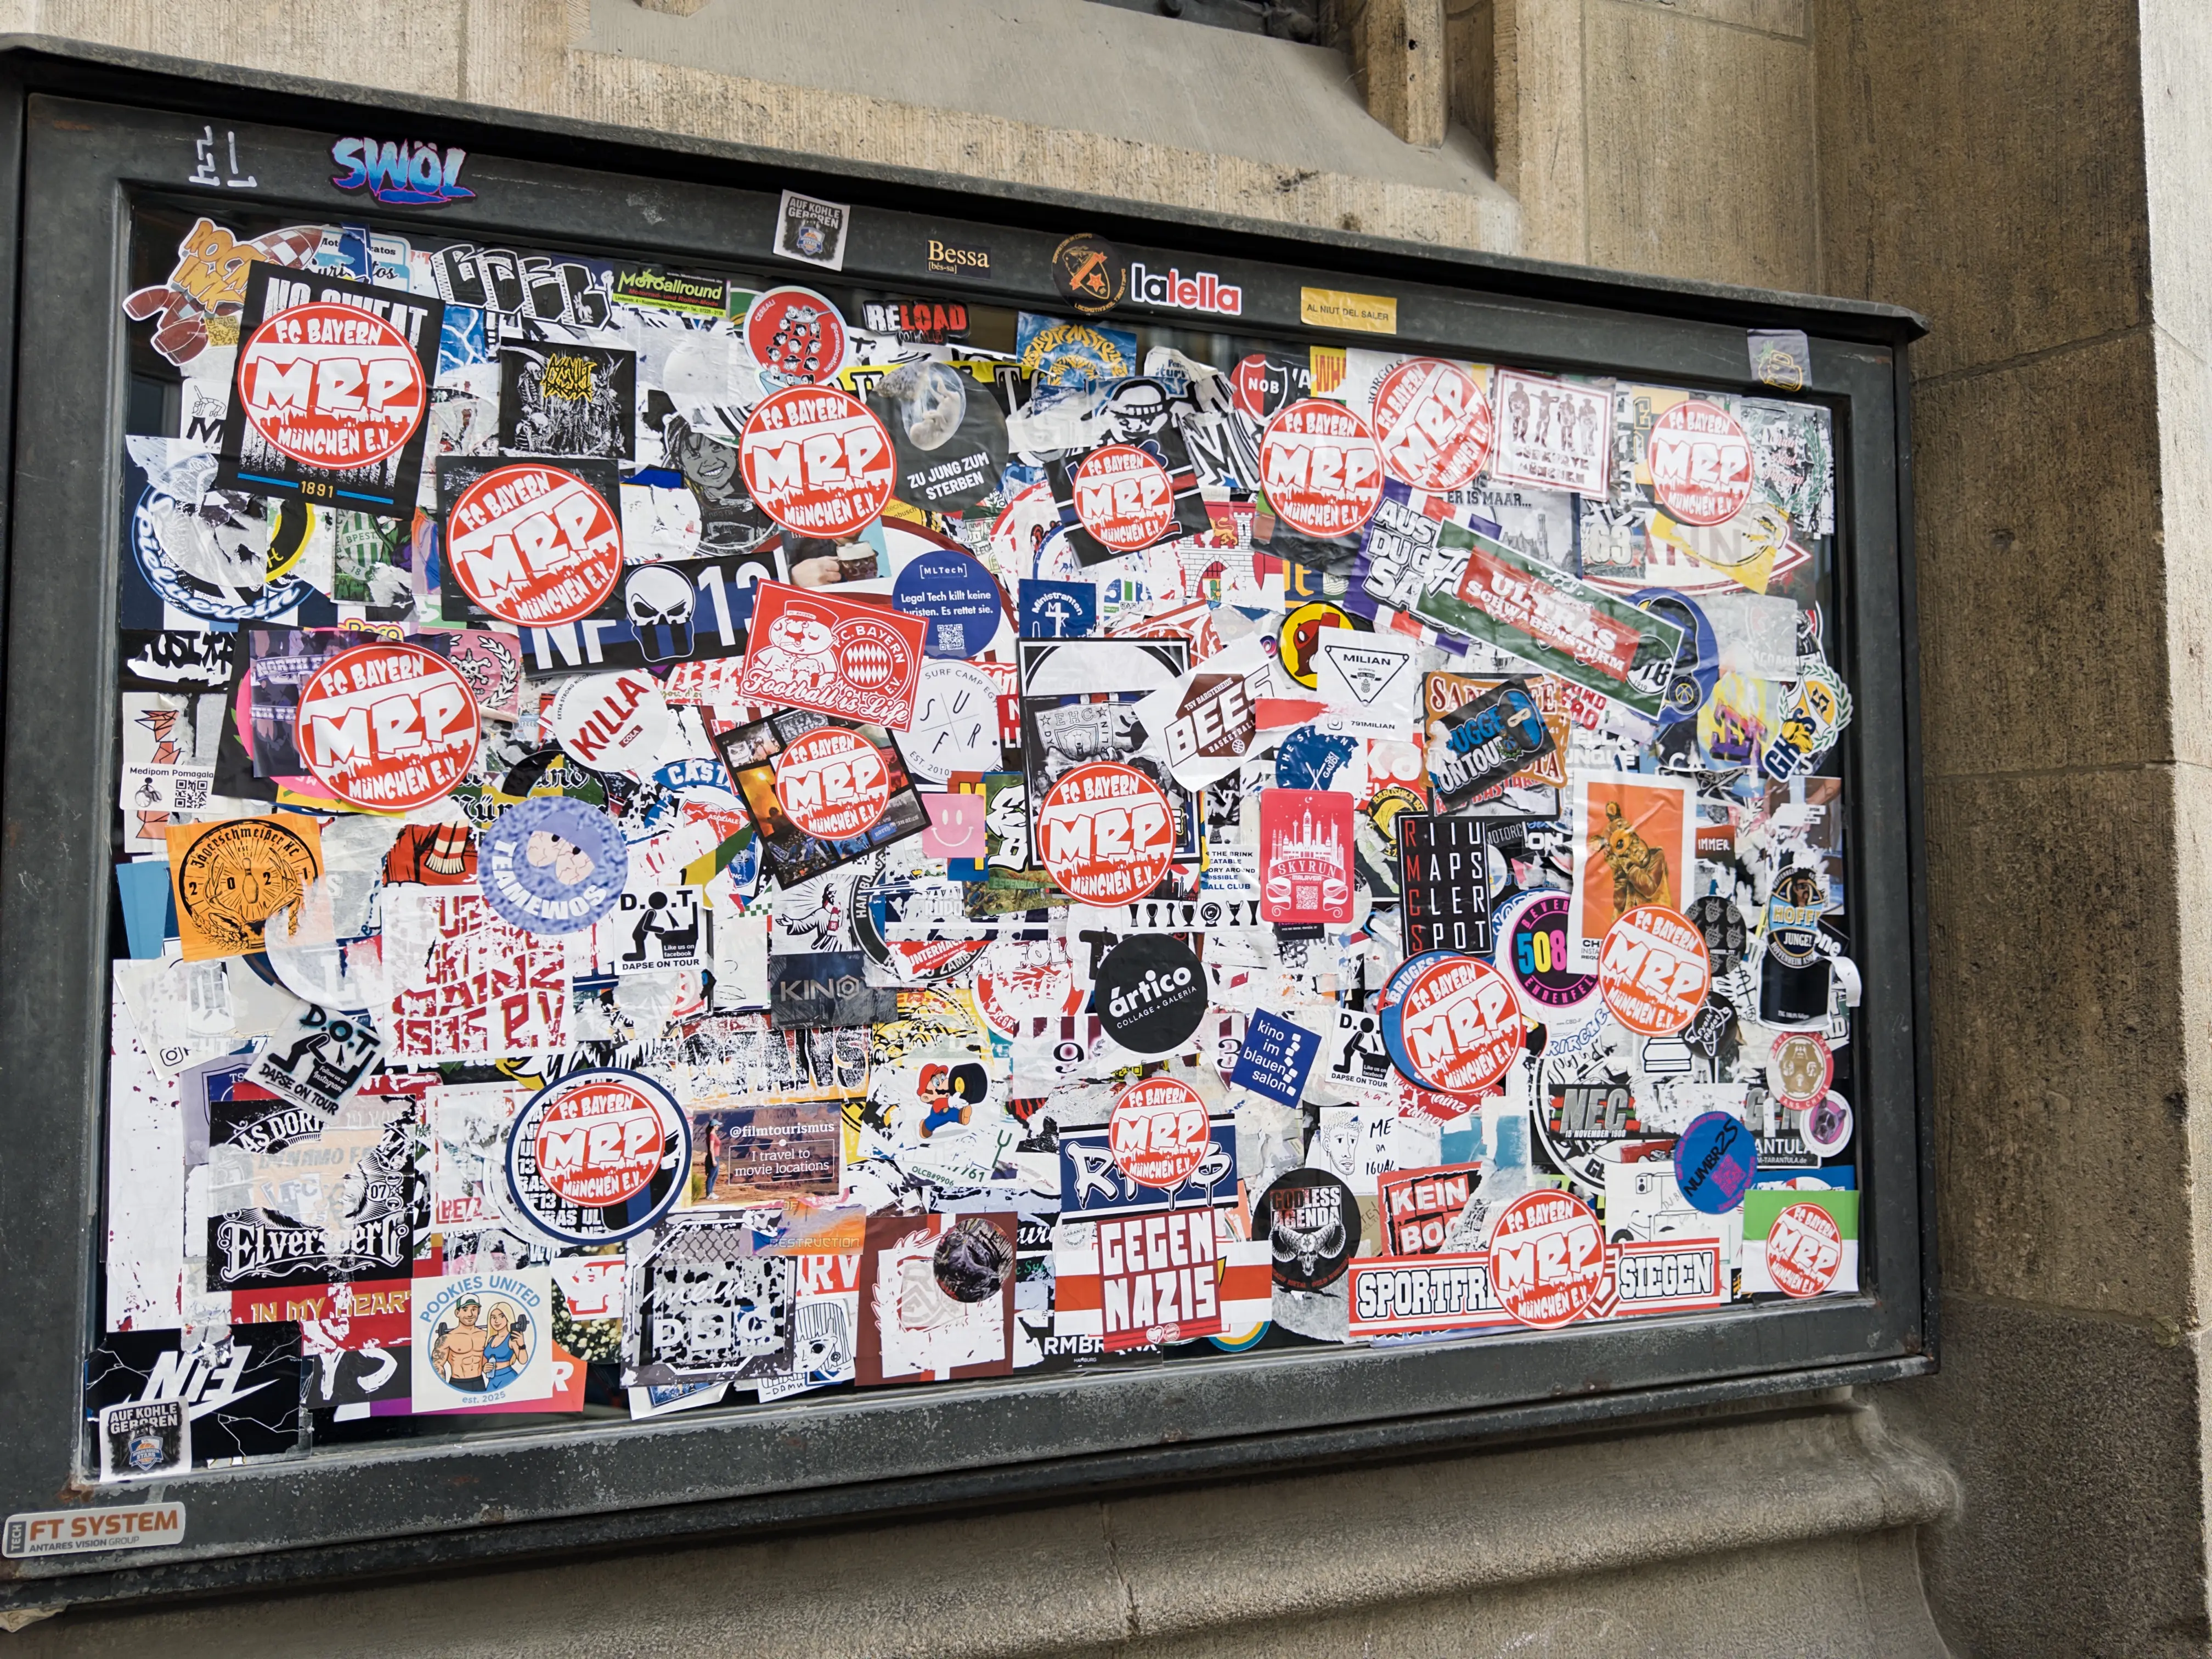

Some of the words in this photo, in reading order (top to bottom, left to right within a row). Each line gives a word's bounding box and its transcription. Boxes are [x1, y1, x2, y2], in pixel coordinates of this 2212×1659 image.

[332, 137, 475, 196] SWÖL
[787, 207, 839, 229] GEBOREN
[789, 198, 807, 211] AUF
[808, 202, 840, 218] KOHLE
[928, 240, 989, 268] Bessa
[618, 269, 723, 300] Motoallround
[1133, 263, 1240, 314] lalella
[754, 300, 776, 321] CEREALI
[866, 303, 967, 331] RELOAD
[1307, 304, 1318, 313] AL
[1320, 306, 1340, 315] NIUT
[1343, 308, 1359, 317] DEL
[1361, 311, 1389, 321] SALER
[275, 319, 301, 344] FC
[308, 318, 384, 345] BAYERN
[251, 357, 414, 413] MRP
[1248, 379, 1280, 395] NOB
[761, 408, 784, 430] FC
[785, 398, 848, 426] BAYERN
[1285, 415, 1301, 434] FC
[1306, 414, 1357, 437] BAYERN
[1390, 368, 1464, 480] MRP
[1669, 413, 1685, 430] FC
[1688, 411, 1730, 435] BAYERN
[366, 430, 394, 452] E.V.
[752, 426, 883, 494] MRP
[907, 472, 926, 489] ZU
[928, 461, 962, 483] JUNG
[964, 452, 989, 475] ZUM
[1268, 442, 1377, 493] MRP
[1654, 438, 1747, 485] MRP
[301, 480, 335, 499] 1891
[926, 472, 985, 501] STERBEN
[1081, 474, 1165, 521] MRP
[1447, 493, 1463, 504] ER
[1466, 494, 1480, 505] IS
[459, 505, 488, 531] FC
[484, 472, 552, 519] BAYERN
[853, 493, 879, 516] E.V.
[1718, 496, 1735, 514] E.V.
[1342, 508, 1362, 524] E.V.
[462, 490, 598, 599] MRP
[585, 560, 614, 593] E.V.
[901, 592, 926, 605] Legal
[927, 592, 947, 602] Tech
[949, 591, 965, 601] killt
[968, 590, 991, 601] keine
[941, 606, 952, 615] Es
[954, 605, 976, 615] rettet
[979, 606, 993, 614] sie.
[1031, 591, 1084, 617] Ministranten
[855, 625, 906, 664] BAYERN
[1344, 654, 1391, 666] MILIAN
[320, 670, 348, 697] FC
[349, 655, 425, 691] BAYERN
[884, 677, 903, 695] E.V.
[925, 668, 950, 680] SURF
[955, 669, 984, 686] CAMP
[560, 683, 575, 703] STRONG
[742, 668, 840, 709] Football
[838, 689, 859, 713] is
[860, 696, 910, 727] Life
[311, 681, 466, 767] MRP
[569, 676, 650, 762] KILLA
[1054, 708, 1094, 726] EHC
[1351, 720, 1395, 730] 791MILIAN
[622, 729, 640, 744] COLA
[1208, 719, 1257, 754] BASKETBALL
[433, 756, 461, 783] E.V.
[910, 751, 927, 767] EST.
[928, 764, 950, 776] 2010
[1324, 751, 1335, 764] SKI
[130, 766, 169, 776] Medipom
[785, 754, 881, 812] MRP
[1060, 782, 1081, 803] FC
[1086, 776, 1139, 802] BAYERN
[1372, 787, 1414, 804] BABUSHKA
[1049, 803, 1166, 864] MRP
[1697, 837, 1730, 853] IMMER
[492, 840, 607, 919] TEAMEWOS
[1135, 866, 1155, 885] E.V.
[1277, 860, 1338, 878] SKYRUN
[1634, 910, 1650, 930] FC
[1650, 917, 1700, 952] BAYERN
[622, 961, 654, 970] DAPSE
[656, 960, 672, 968] ON
[673, 958, 699, 968] TOUR
[1603, 930, 1705, 1002] MRP
[1108, 967, 1192, 1019] ártico
[1412, 988, 1430, 1011] FC
[1431, 964, 1478, 998] BAYERN
[1257, 1020, 1285, 1041] kino
[1411, 979, 1510, 1069] MRP
[1656, 1012, 1674, 1029] E.V.
[1262, 1040, 1280, 1056] im
[1494, 1041, 1516, 1063] E.V.
[1243, 1047, 1286, 1075] blauen
[258, 1063, 297, 1091] DAPSE
[294, 1083, 313, 1101] ON
[310, 1091, 340, 1116] TOUR
[1251, 1069, 1287, 1092] salon
[560, 1102, 578, 1120] FC
[580, 1093, 634, 1117] BAYERN
[1559, 1088, 1629, 1131] NEC
[730, 1121, 835, 1139] @filmtourismus
[1115, 1109, 1204, 1153] MRP
[1370, 1117, 1394, 1139] ME
[1565, 1130, 1573, 1138] 15
[1574, 1129, 1609, 1138] NOVEMBER
[1611, 1128, 1627, 1137] 1900
[545, 1116, 658, 1171] MRP
[752, 1150, 757, 1162] I
[759, 1148, 795, 1161] travel
[798, 1148, 810, 1160] to
[1376, 1144, 1385, 1153] DA
[735, 1164, 772, 1177] movie
[775, 1160, 830, 1175] locations
[912, 1166, 954, 1186] OLCB#9906
[1366, 1159, 1396, 1176] IGUAL
[622, 1171, 643, 1190] E.V.
[1271, 1187, 1341, 1210] GODLESS
[1391, 1176, 1467, 1216] KEIN
[1272, 1208, 1340, 1229] AGENDA
[1100, 1210, 1215, 1277] GEGEN
[1772, 1222, 1838, 1274] MRP
[1499, 1223, 1598, 1292] MRP
[420, 1276, 483, 1323] POOKIES
[489, 1274, 541, 1308] UNITED
[1104, 1266, 1217, 1333] NAZIS
[462, 1395, 480, 1404] est.
[482, 1390, 506, 1403] 2025
[110, 1410, 133, 1423] AUF
[136, 1403, 178, 1419] KOHLE
[110, 1414, 178, 1435] GEBOREN
[10, 1524, 21, 1551] TECH
[29, 1518, 65, 1541] FT
[71, 1510, 178, 1538] SYSTEM
[29, 1541, 73, 1553] ANTARES
[75, 1539, 106, 1549] VISION
[109, 1536, 139, 1547] GROUP
